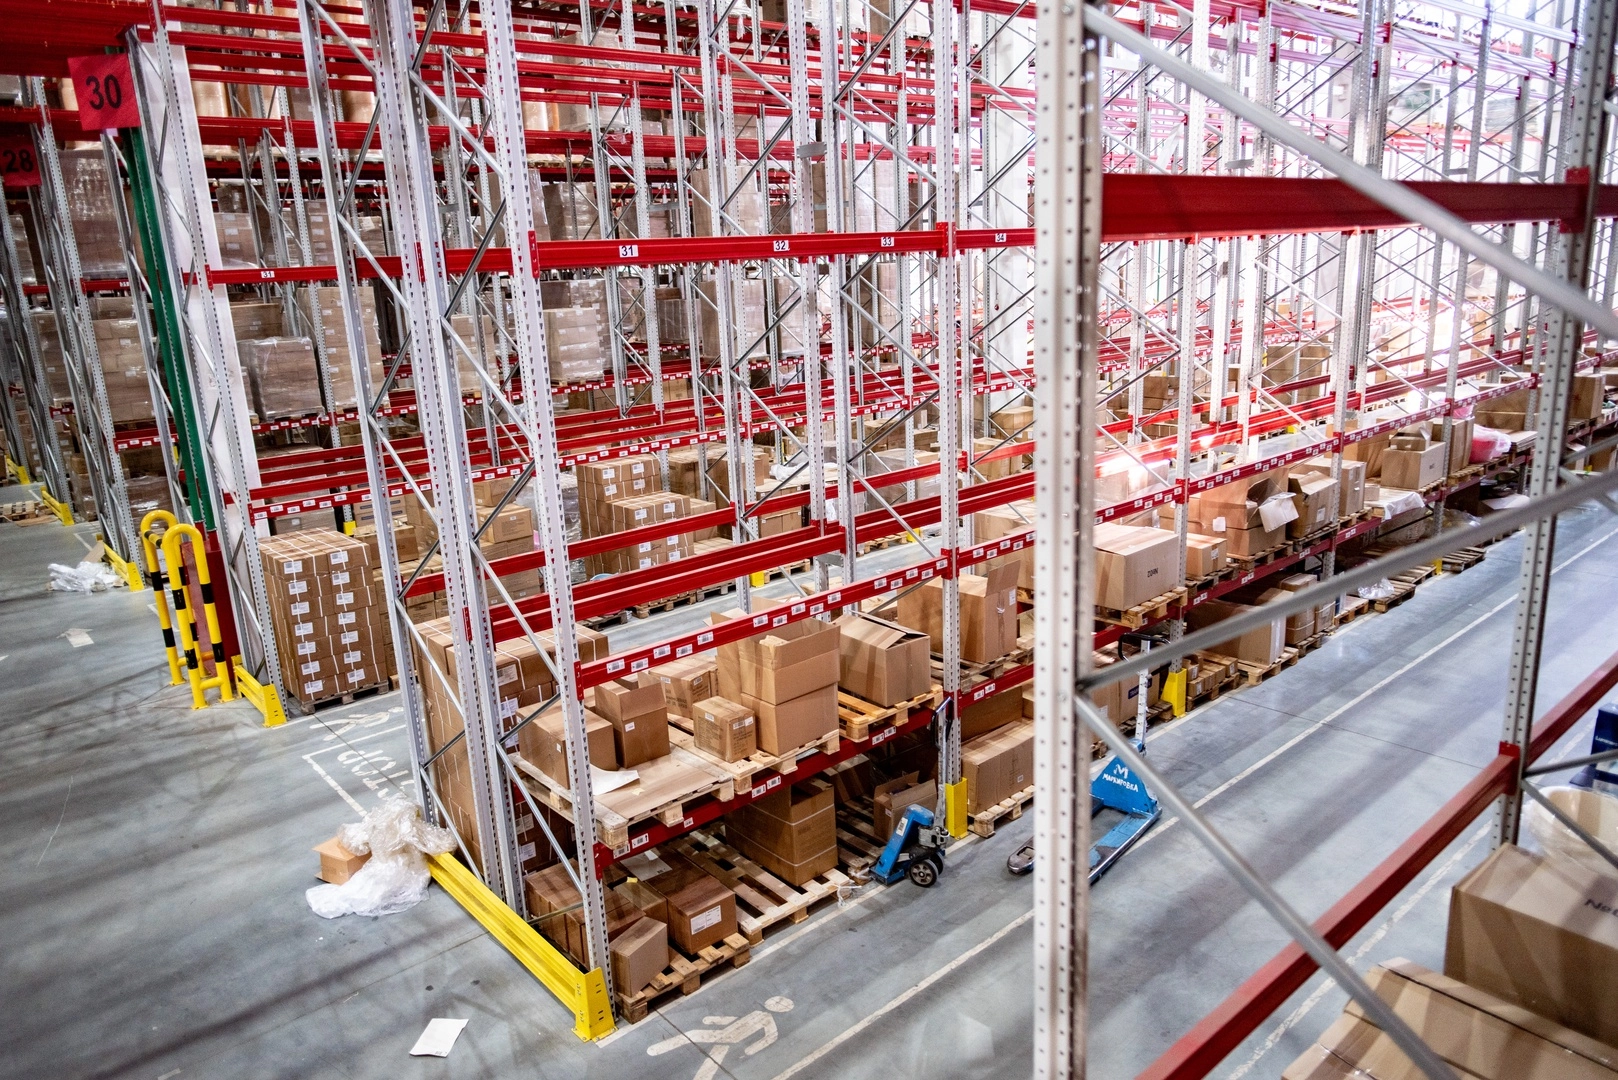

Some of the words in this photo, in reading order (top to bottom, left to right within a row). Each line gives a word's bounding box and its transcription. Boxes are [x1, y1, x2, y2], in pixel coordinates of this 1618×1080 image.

[85, 74, 122, 110] 30
[3, 149, 34, 173] 28
[775, 240, 786, 251] 32
[882, 237, 892, 246] 33
[621, 245, 635, 257] 31
